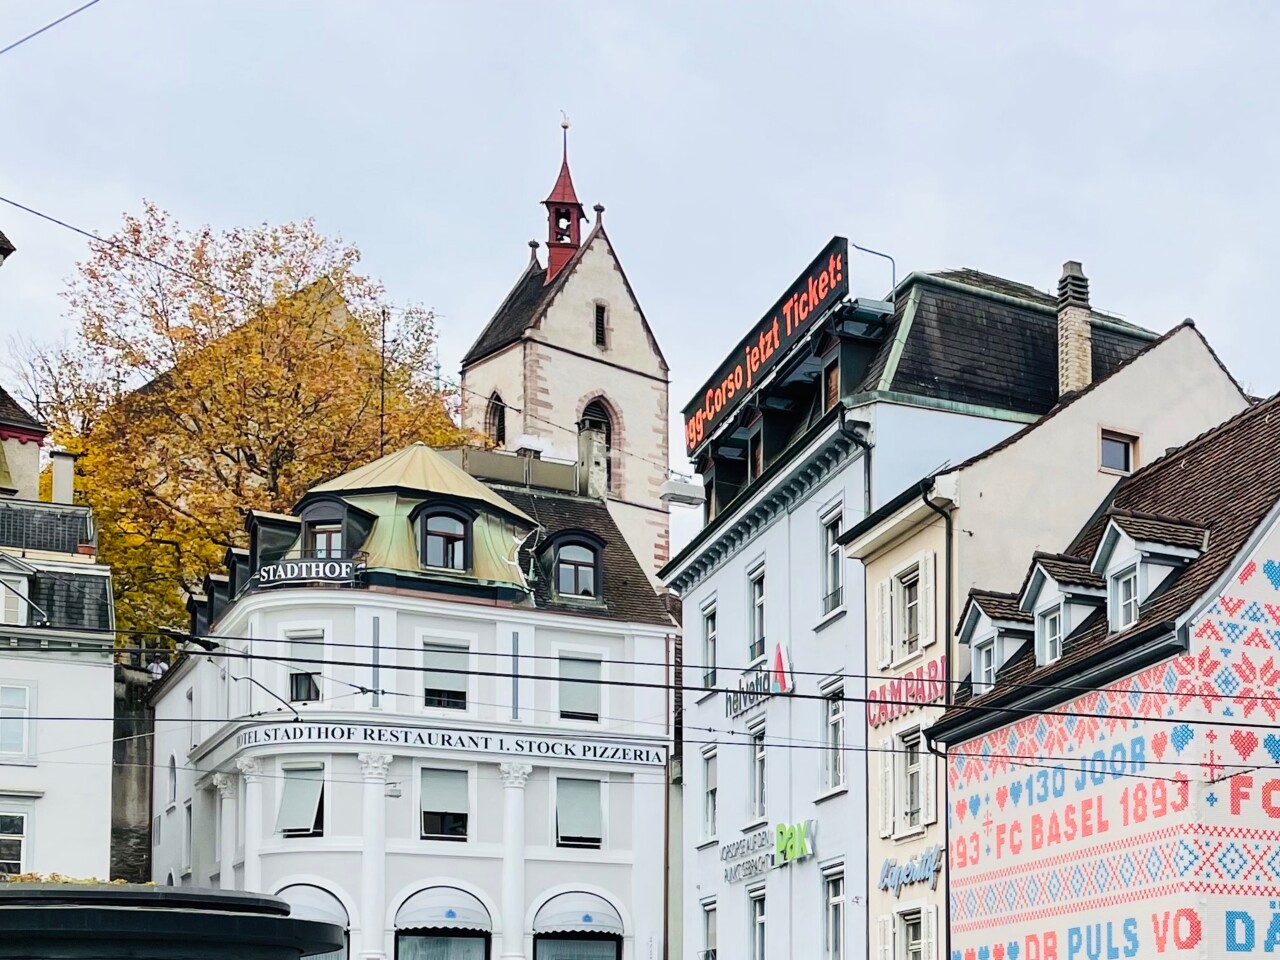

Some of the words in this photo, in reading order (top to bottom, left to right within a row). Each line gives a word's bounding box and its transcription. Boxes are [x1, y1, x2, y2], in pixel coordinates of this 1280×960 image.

[745, 316, 780, 388] jetzt
[259, 561, 353, 583] STADTHOF
[868, 655, 946, 728] CAMPARI
[263, 726, 358, 742] STADTHOF
[363, 728, 493, 750] RESTAURANT
[498, 738, 510, 752] 1.
[515, 739, 576, 757] STOCK
[582, 745, 663, 764] PIZZERIA
[1025, 764, 1065, 806] 130
[1074, 735, 1146, 792] JOOR
[996, 819, 1022, 860] FC
[1031, 795, 1109, 851] BASEL
[1119, 770, 1189, 827] 1893
[1151, 908, 1202, 953] VO
